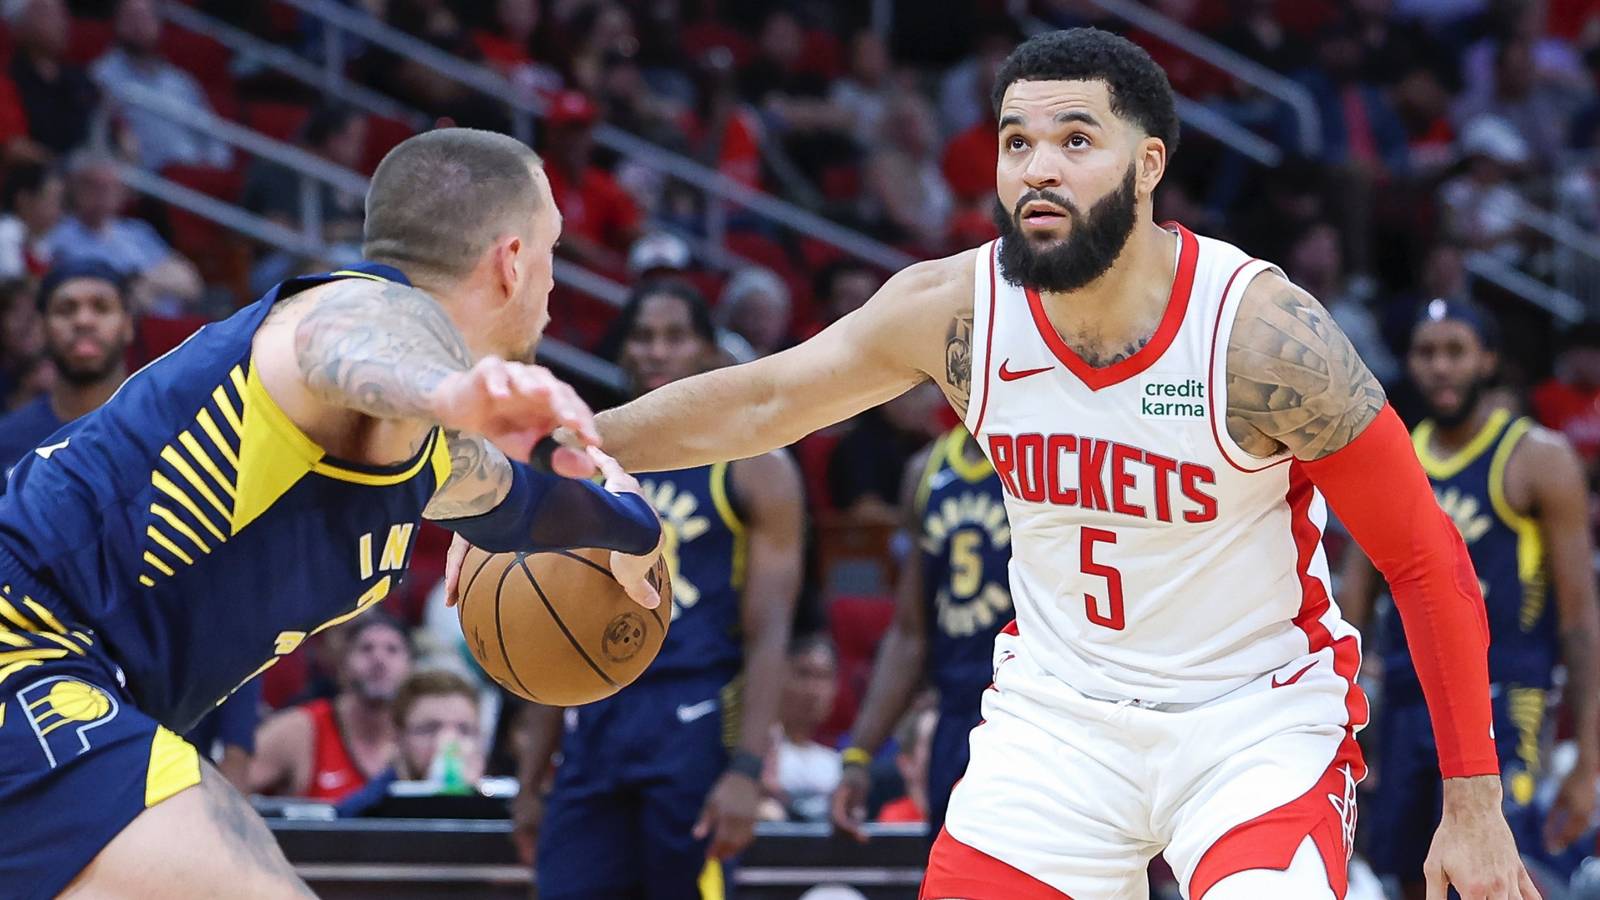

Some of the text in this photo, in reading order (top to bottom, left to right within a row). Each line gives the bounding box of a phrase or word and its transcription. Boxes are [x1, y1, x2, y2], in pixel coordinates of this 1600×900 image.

[1142, 397, 1204, 417] karma
[1145, 379, 1205, 398] credit
[988, 433, 1218, 524] ROCKETS
[951, 529, 984, 599] 5
[1080, 526, 1126, 631] 5
